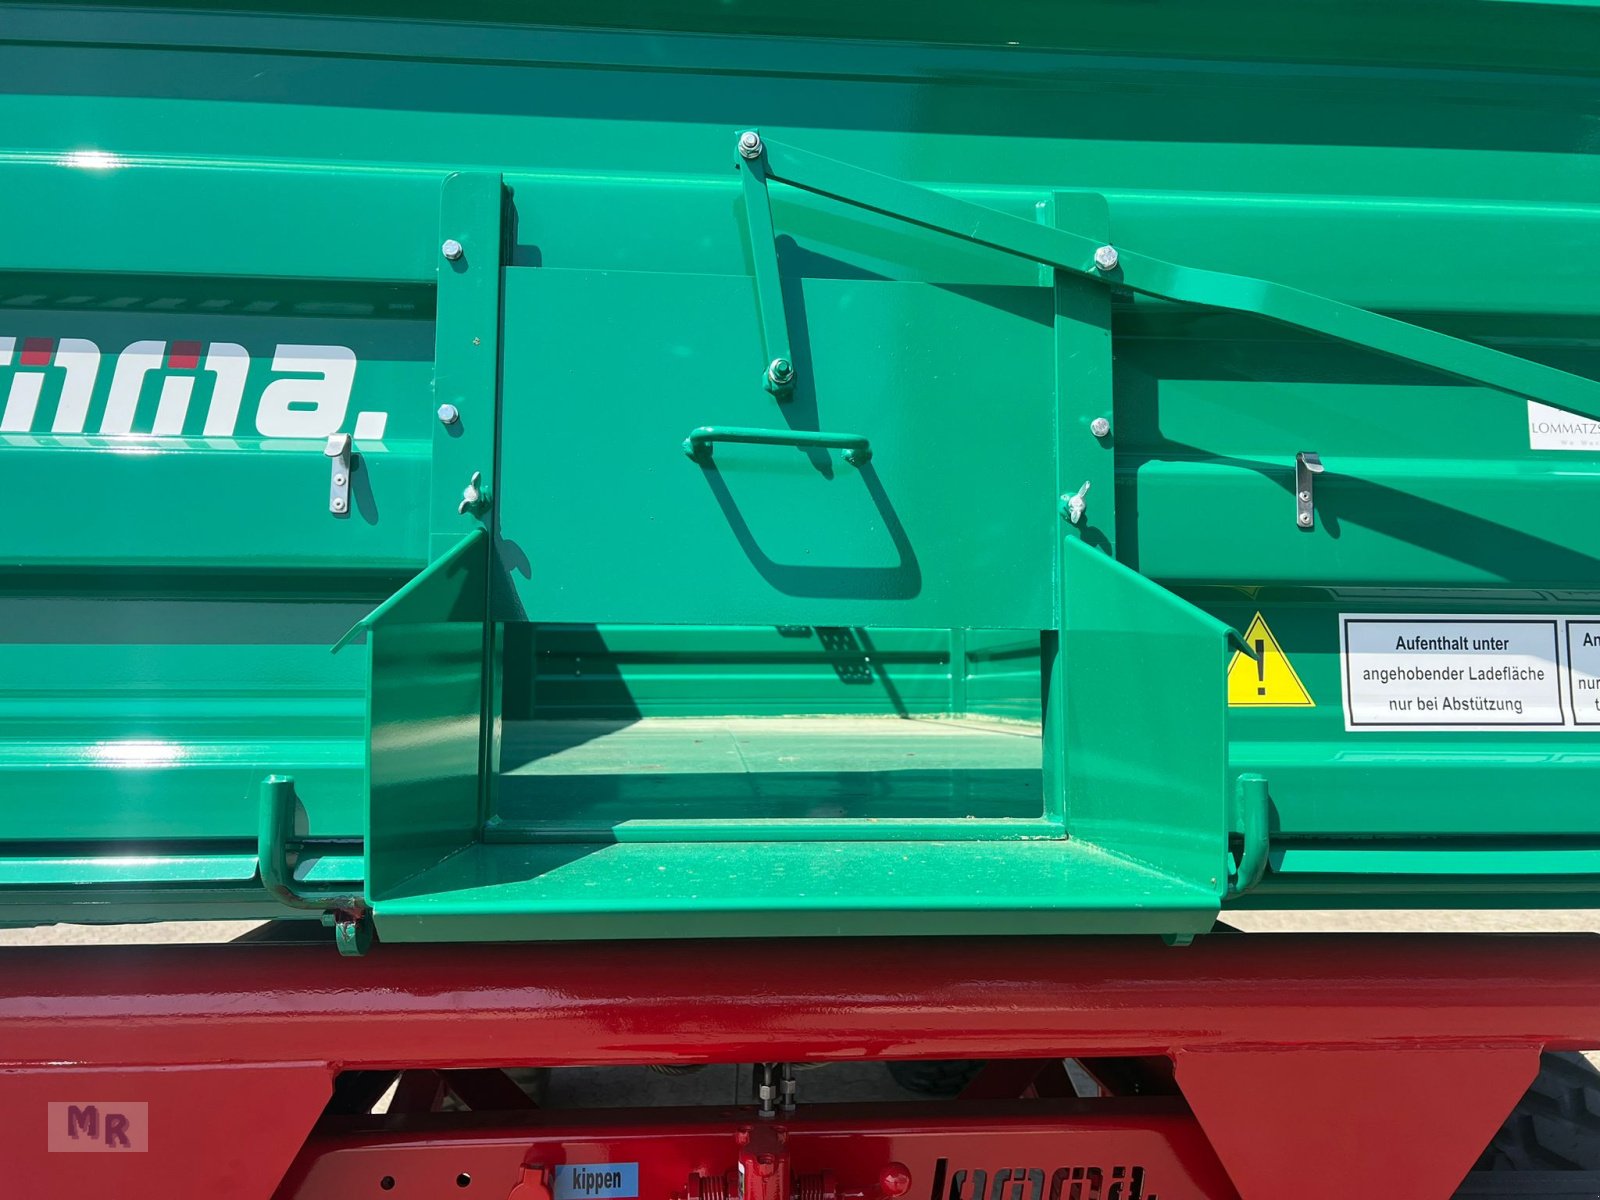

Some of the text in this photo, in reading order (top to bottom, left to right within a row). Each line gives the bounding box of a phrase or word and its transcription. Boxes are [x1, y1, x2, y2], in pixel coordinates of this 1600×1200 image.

[1396, 635, 1509, 650] Aufenthalt unter
[1363, 666, 1545, 683] angehobender Ladefläche
[1389, 697, 1523, 714] nur bei Abstützung
[572, 1167, 621, 1194] kippen
